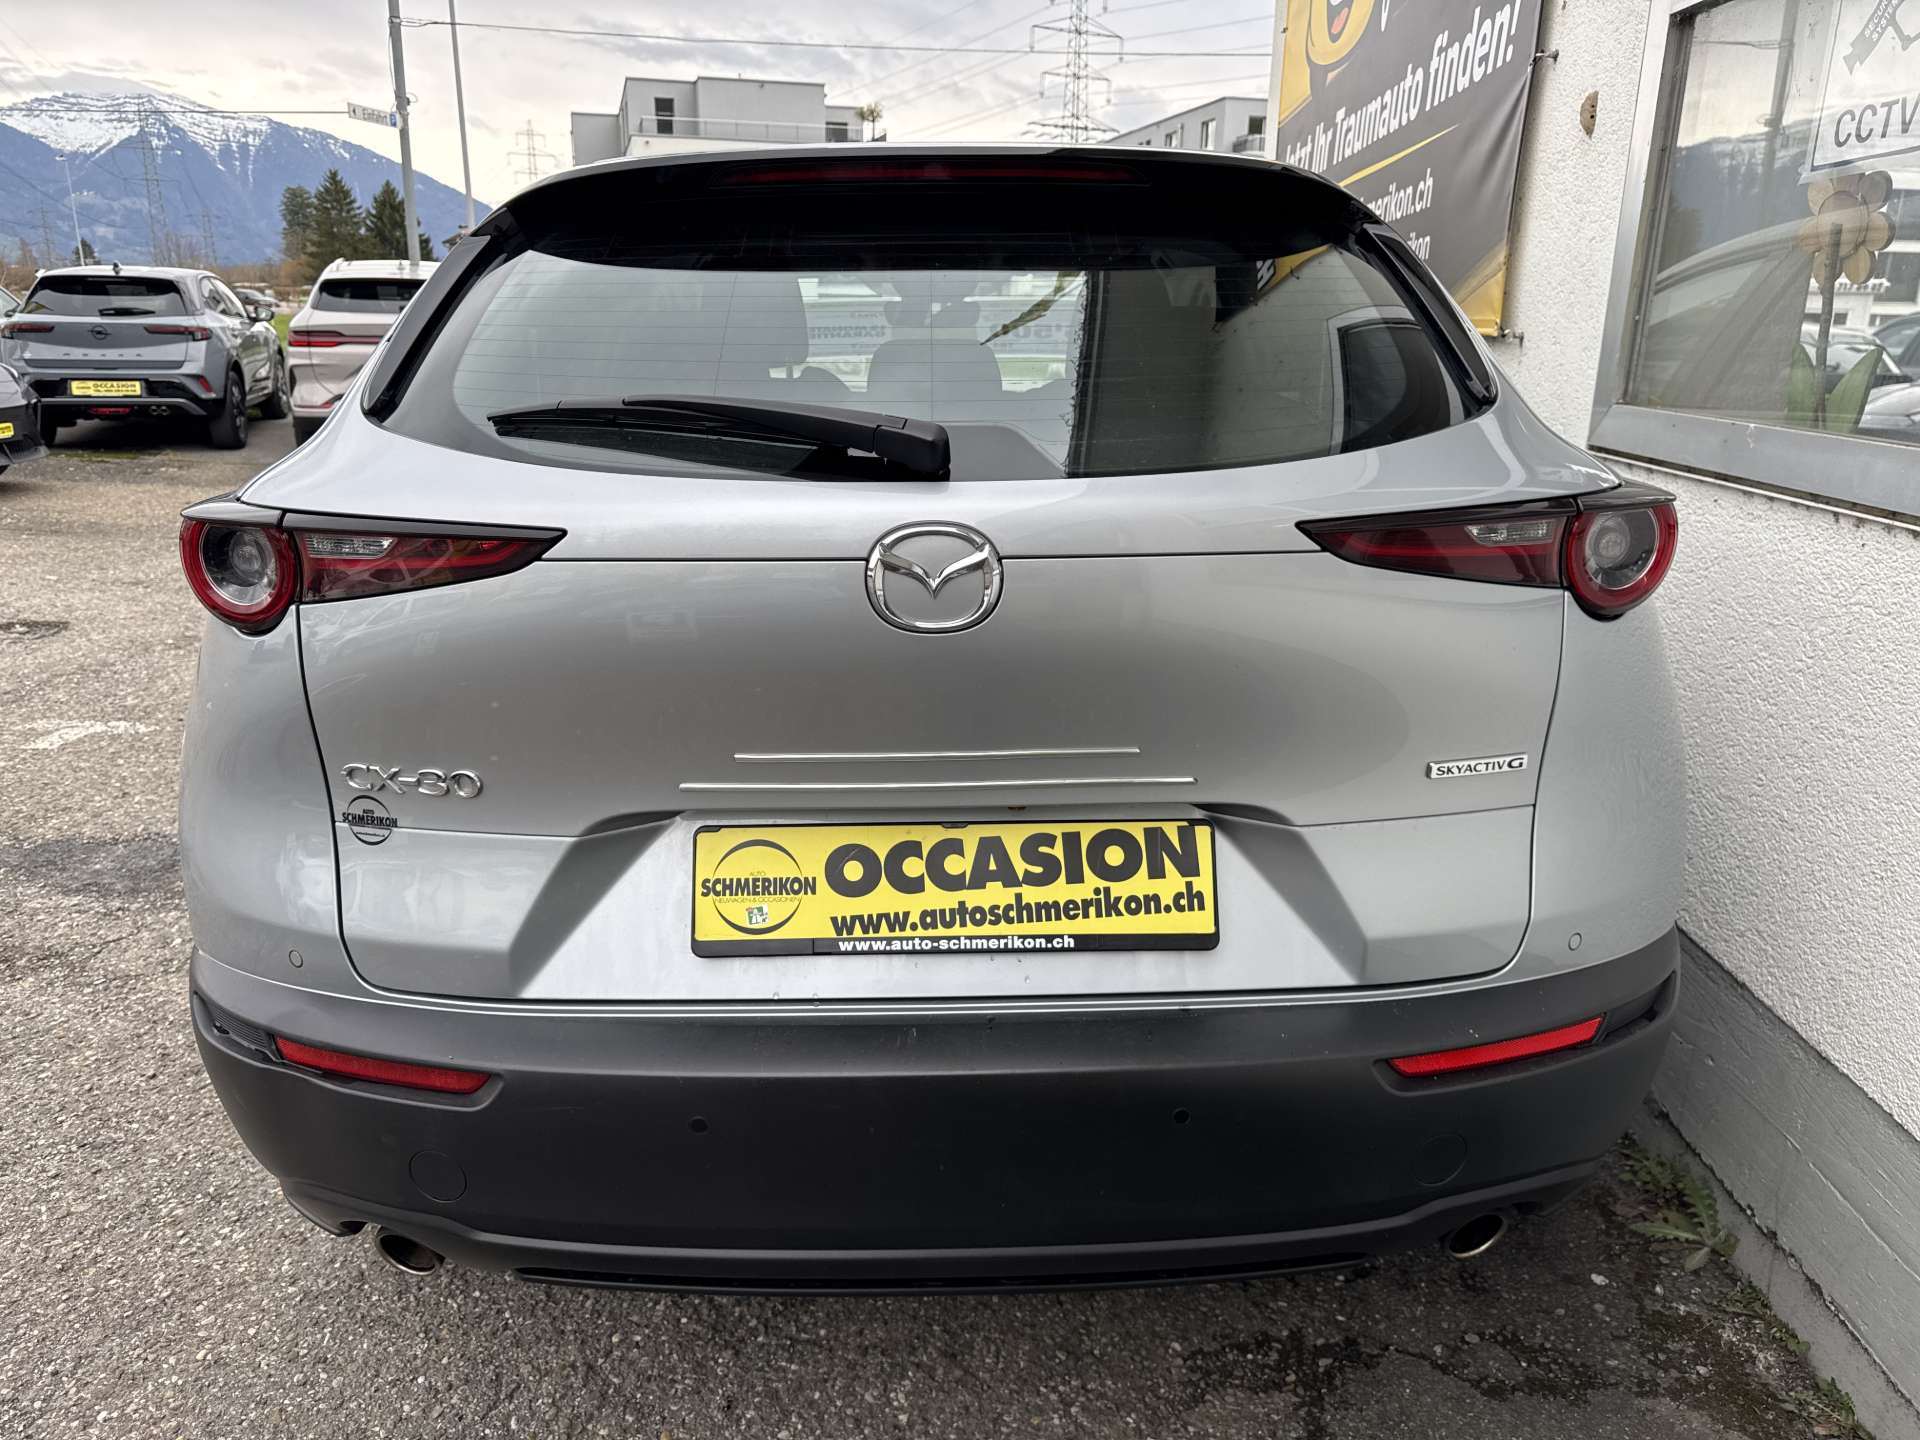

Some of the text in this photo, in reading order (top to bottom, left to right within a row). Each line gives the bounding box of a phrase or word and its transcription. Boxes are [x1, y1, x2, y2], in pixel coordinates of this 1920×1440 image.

[1311, 122, 1334, 174] Ihr
[1333, 63, 1423, 165] Traumauto
[1425, 0, 1521, 112] finden!
[1834, 93, 1920, 148] CCTV
[1361, 168, 1434, 224] erikon.ch
[340, 763, 483, 799] CX-30
[342, 812, 398, 828] SCHMERIKON
[824, 825, 1201, 898] OCCASION
[701, 876, 817, 898] SCHMERIKON
[715, 897, 751, 905] NEUWAGEN
[758, 896, 801, 904] OCCASIONEN
[830, 880, 1206, 937] www.autoschmerikon.ch
[838, 934, 1075, 951] www.auto-schmerikon.ch
